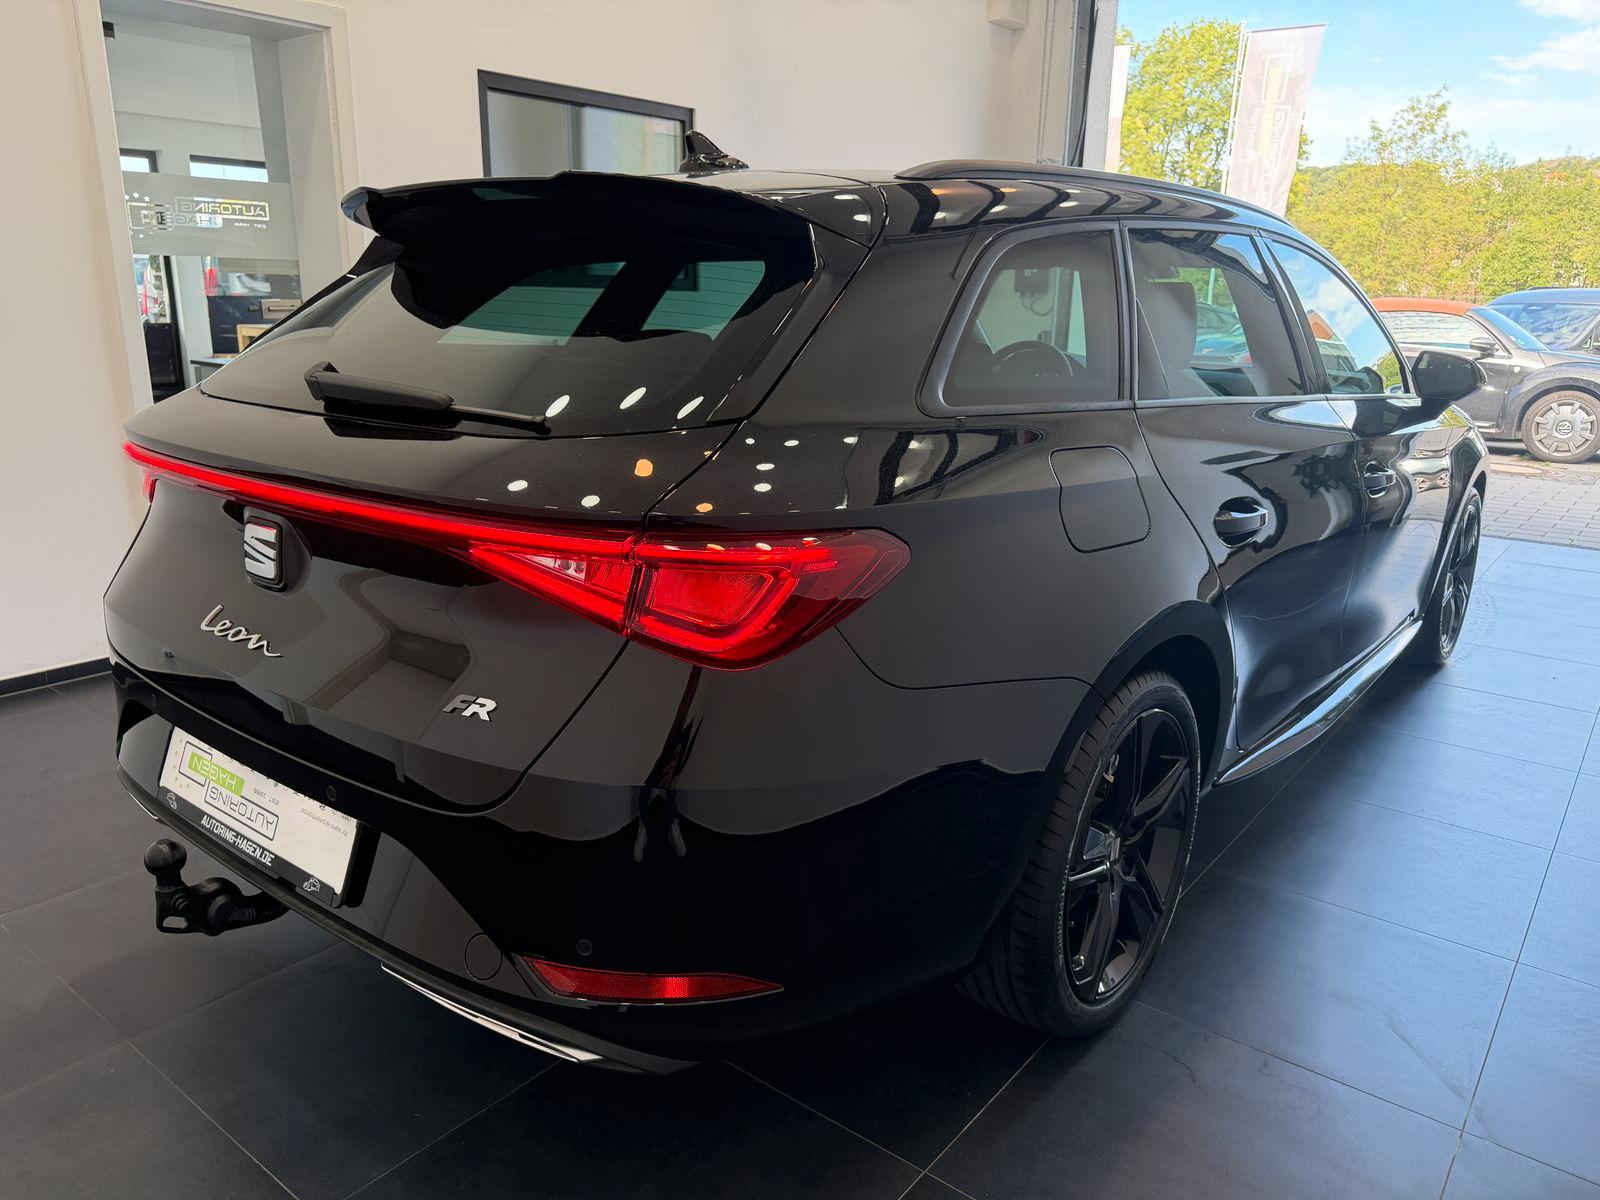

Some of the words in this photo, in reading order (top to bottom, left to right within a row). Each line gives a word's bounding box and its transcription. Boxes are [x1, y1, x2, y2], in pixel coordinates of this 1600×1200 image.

[200, 604, 284, 657] Leon
[442, 694, 497, 721] FR
[191, 757, 237, 791] HAGEN
[208, 786, 275, 831] AUTORING
[200, 814, 275, 867] AUTORING-HAGEN.DE
